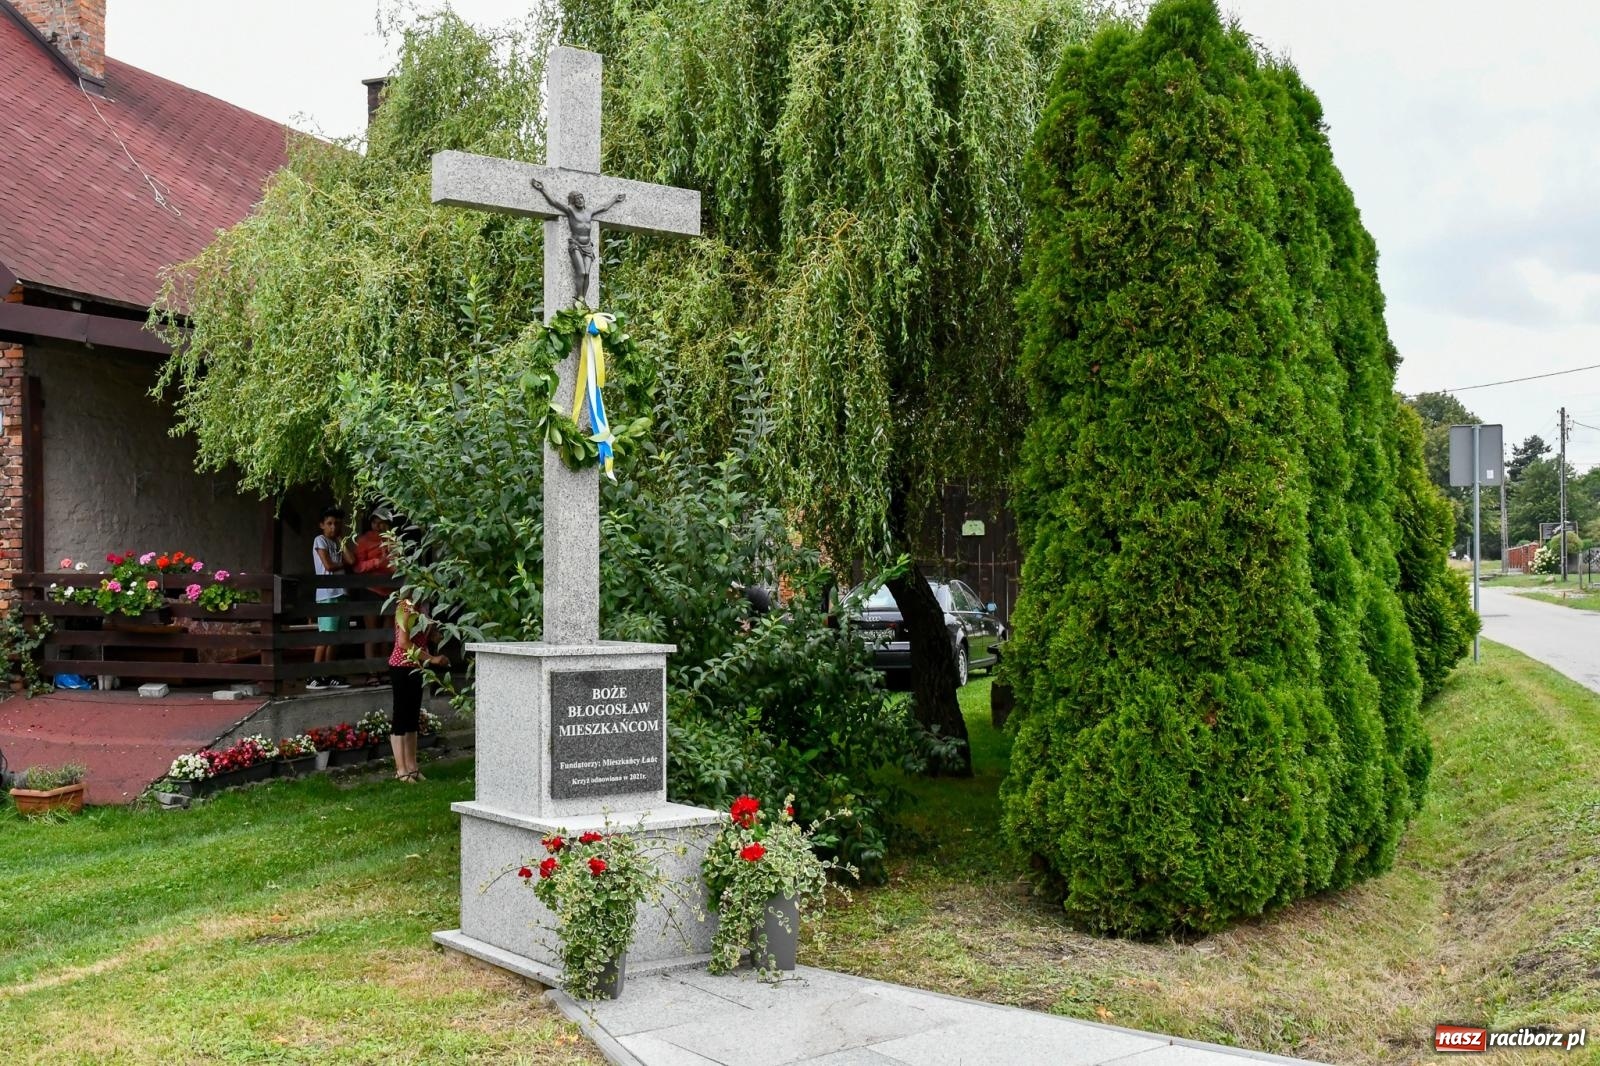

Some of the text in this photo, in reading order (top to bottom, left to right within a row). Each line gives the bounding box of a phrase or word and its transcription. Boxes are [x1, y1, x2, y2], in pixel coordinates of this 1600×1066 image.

[592, 685, 628, 700] BOŻE
[568, 702, 650, 718] BŁOGOSŁAW
[559, 718, 659, 737] MIESZKAŃCOM
[560, 761, 601, 770] Fundatorzy:
[602, 757, 640, 766] Mieszkańcy
[572, 777, 590, 785] Krzyż
